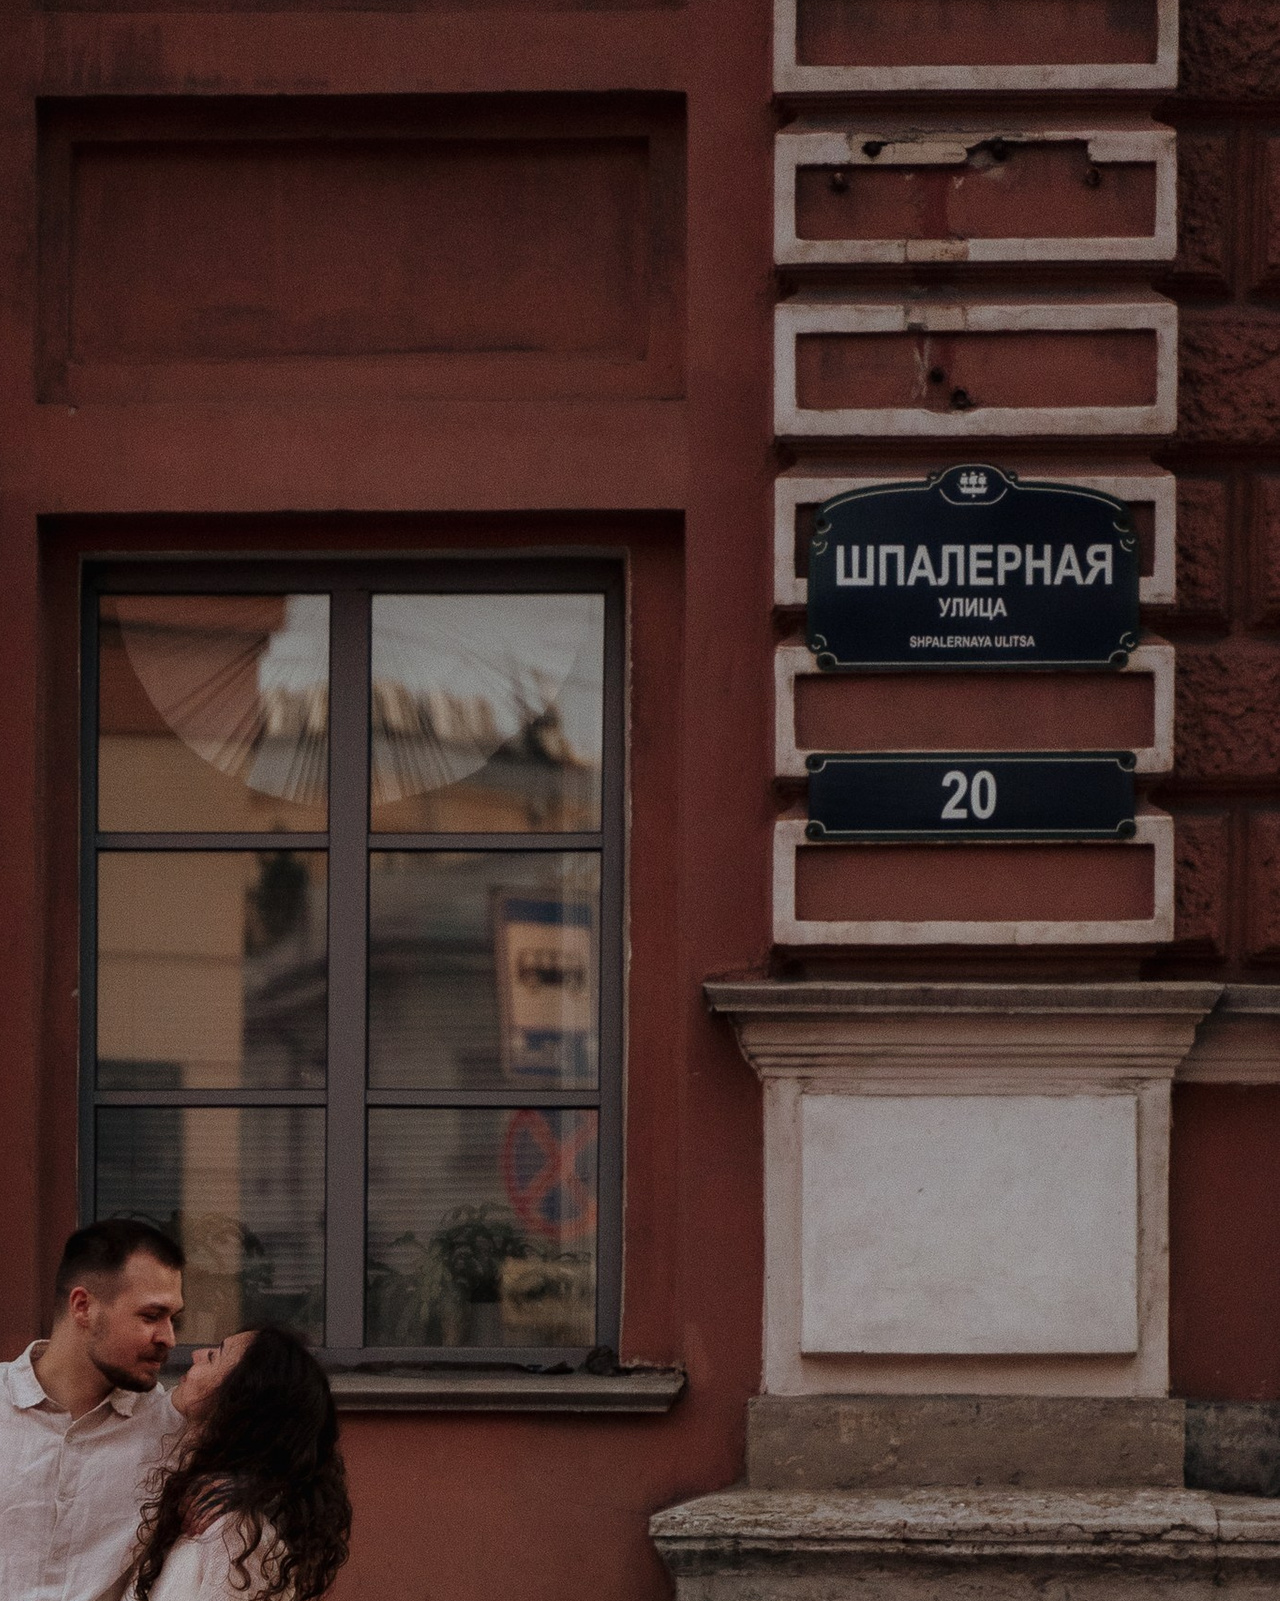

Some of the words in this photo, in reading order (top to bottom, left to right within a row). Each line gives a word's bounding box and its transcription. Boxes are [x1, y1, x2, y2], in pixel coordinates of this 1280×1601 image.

[835, 544, 1113, 587] ШПАЛЕРНАЯ
[938, 597, 1008, 621] УЛИЦА
[909, 635, 993, 649] SHPALERNAYA
[994, 635, 1036, 648] ULITSA
[940, 769, 997, 820] 20
